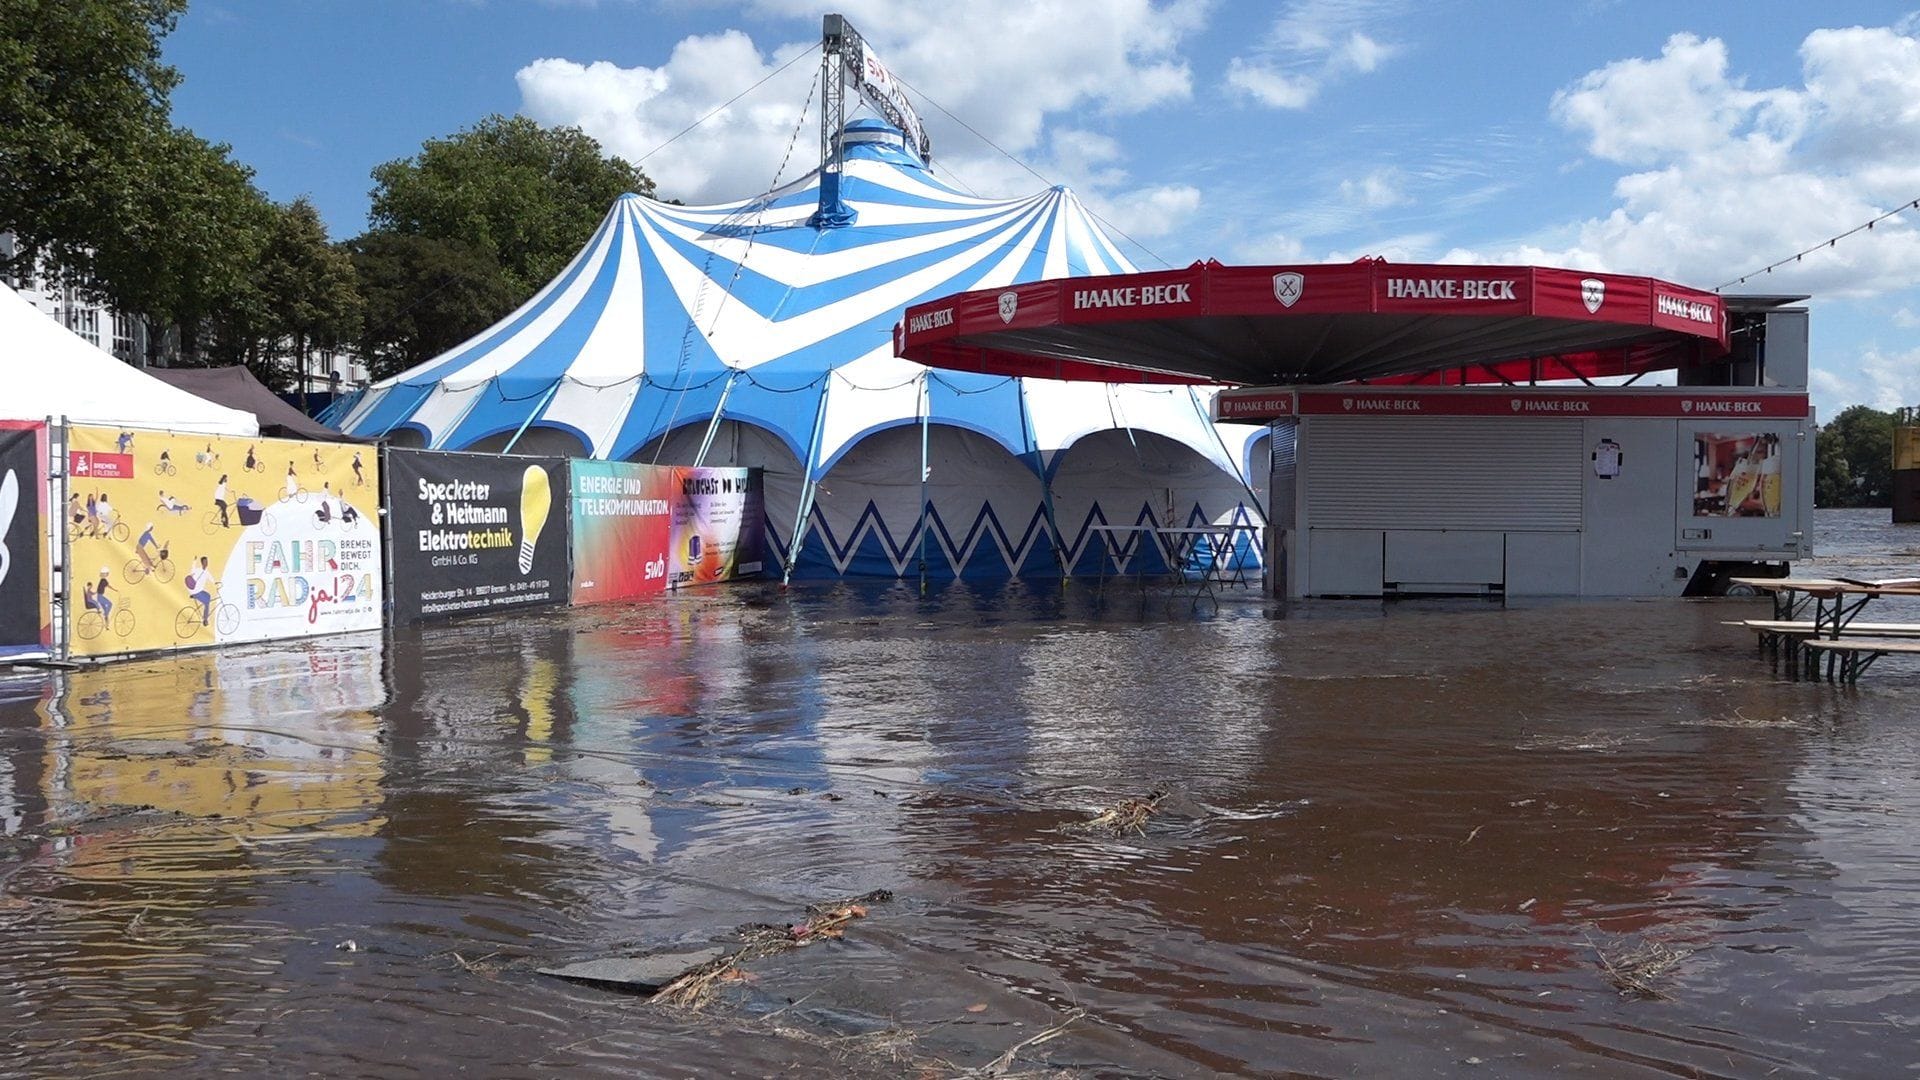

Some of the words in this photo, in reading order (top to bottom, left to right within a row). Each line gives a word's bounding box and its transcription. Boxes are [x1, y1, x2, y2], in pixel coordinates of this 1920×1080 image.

[1074, 283, 1191, 310] HAAKE-BECK
[1387, 278, 1516, 300] HAAKE-BECK
[1657, 294, 1713, 324] HAAKE-BECK
[910, 307, 954, 334] HAAKE-BECK
[1234, 400, 1287, 411] HAAKE-BECK
[1356, 399, 1420, 410] HAAKE-BECK
[1525, 400, 1590, 411] HAAKE-BECK
[1695, 400, 1762, 412] HAAKE-BECK
[418, 478, 490, 505] Specketer
[579, 476, 622, 494] ENERGIE
[623, 478, 641, 495] UND
[431, 503, 443, 525] &
[446, 502, 508, 524] Heitmann
[340, 540, 372, 549] BREMEN
[419, 527, 513, 551] Elektrotechnik
[246, 539, 338, 575] FAHR
[340, 550, 371, 560] BEWEGT
[431, 556, 452, 566] GmbH
[469, 554, 478, 564] KG
[645, 552, 665, 580] swb
[340, 562, 361, 571] DICH.
[246, 575, 310, 609] RAD
